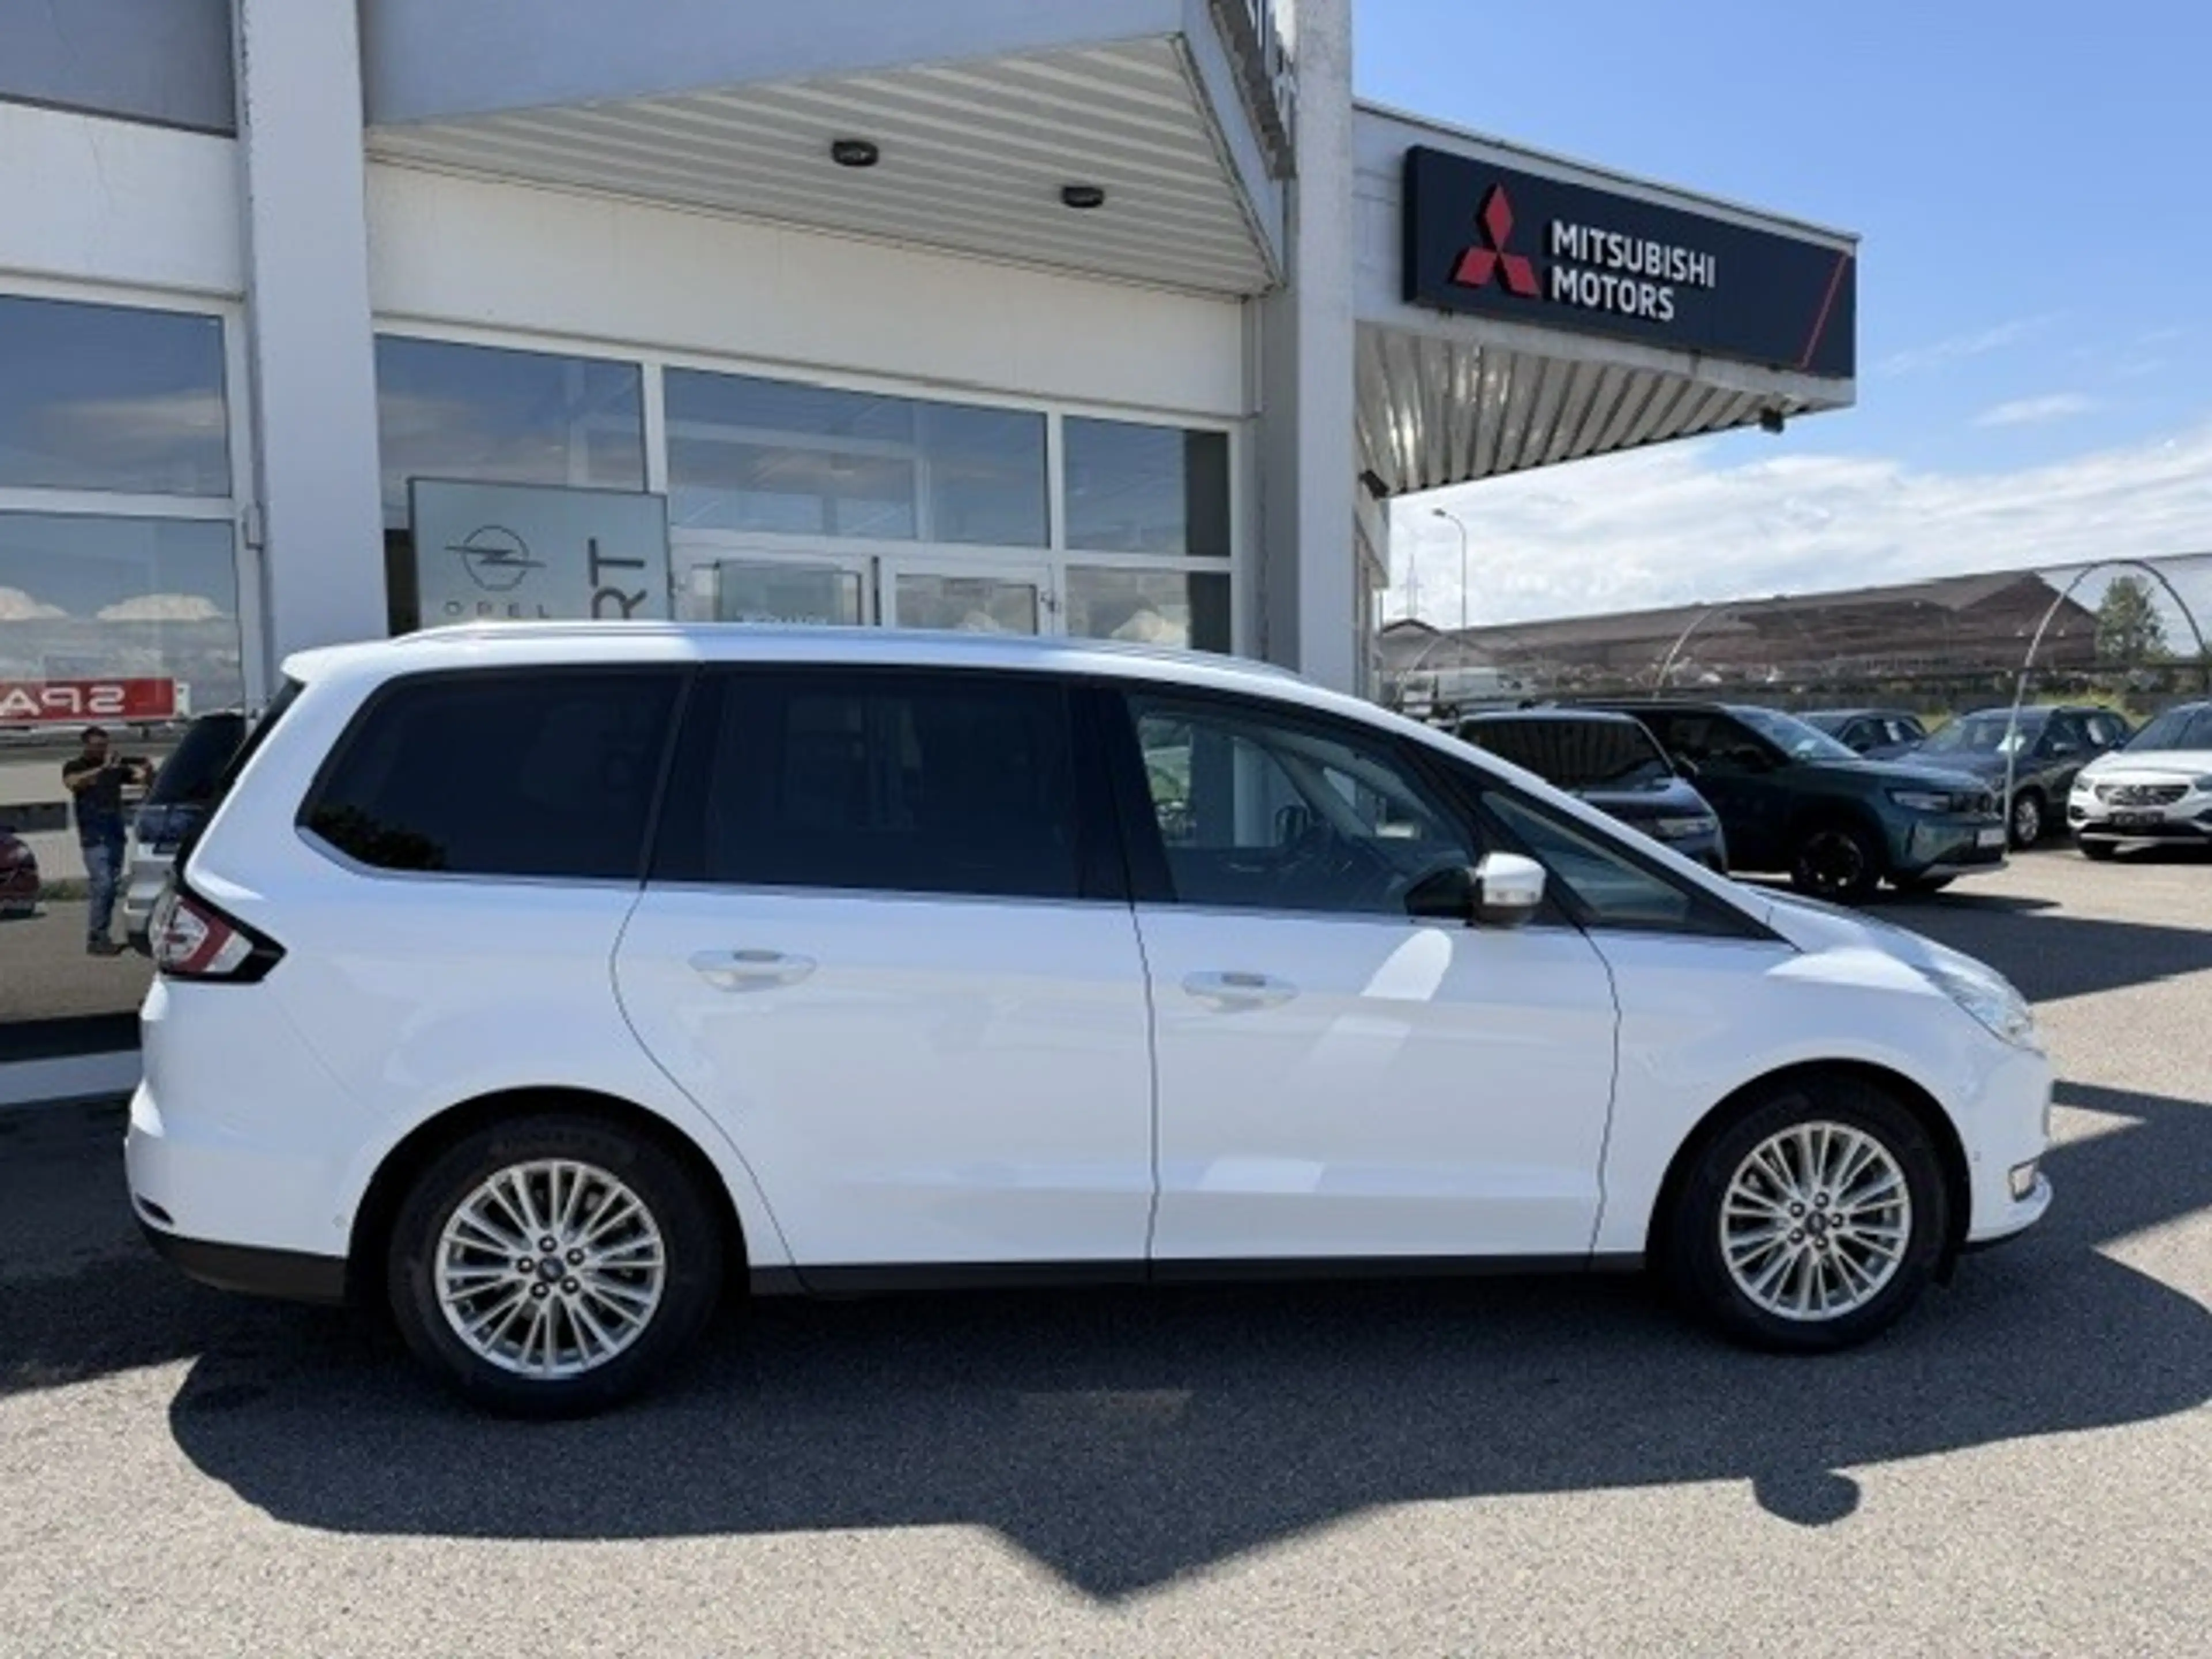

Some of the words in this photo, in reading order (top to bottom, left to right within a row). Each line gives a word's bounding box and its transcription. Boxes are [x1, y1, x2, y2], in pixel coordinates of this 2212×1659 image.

[1552, 219, 1716, 289] MITSUBISHI
[1552, 266, 1675, 321] MOTORS
[444, 601, 550, 619] OPEL
